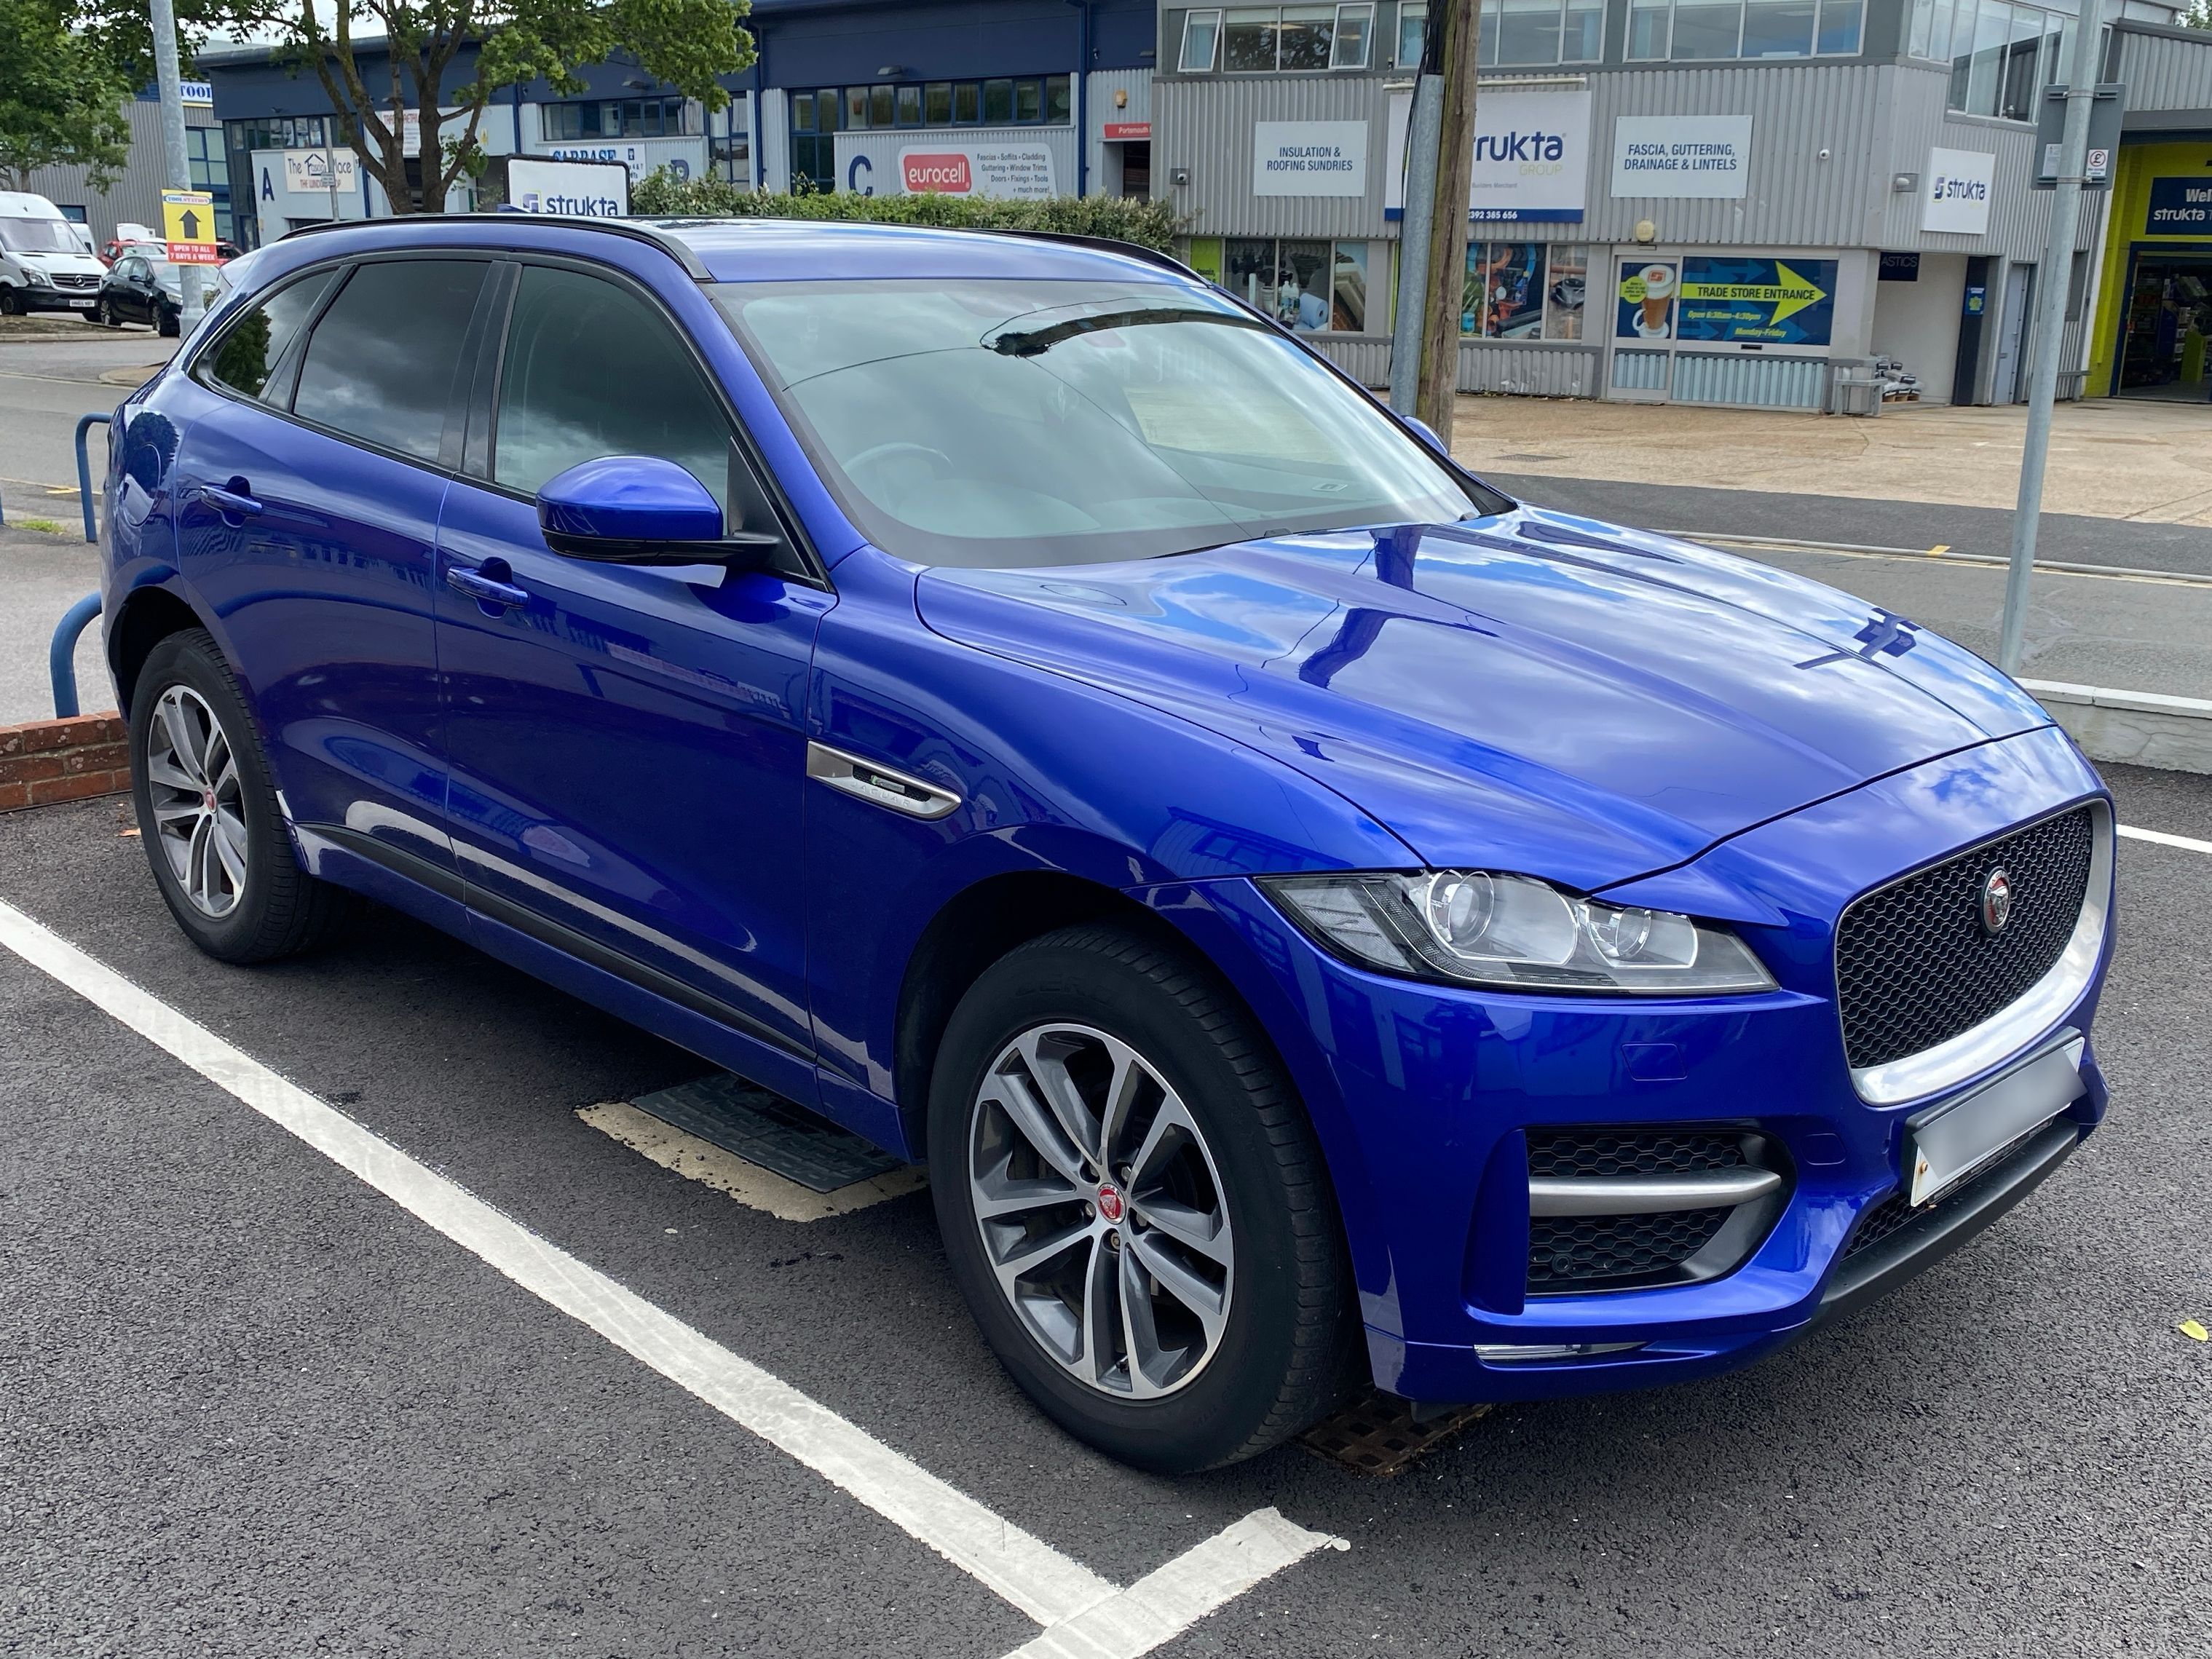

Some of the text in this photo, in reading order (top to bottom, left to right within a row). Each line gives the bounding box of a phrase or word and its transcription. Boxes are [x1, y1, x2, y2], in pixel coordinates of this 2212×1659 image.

[1279, 147, 1341, 157] INSULATION &
[1474, 131, 1563, 161] rukta
[1628, 144, 1735, 157] FASCIA, GUTTERING,
[1022, 153, 1046, 162] Cladding
[288, 158, 302, 174] The
[334, 157, 352, 174] lace
[981, 164, 1006, 173] Guttering
[1267, 160, 1353, 171] ROOFING SUNDRIES
[1520, 165, 1563, 175] GROUP
[1624, 159, 1737, 170] DRAINAGE & LINTELS
[848, 155, 873, 197] C
[909, 162, 965, 183] eurocell
[1011, 175, 1030, 183] Fixings
[262, 167, 275, 201] A
[1947, 178, 1986, 200] strukta
[2186, 189, 2212, 202] Wel
[546, 195, 618, 216] strukta
[1468, 210, 1517, 219] 392 385 656
[2153, 208, 2205, 221] strukta
[1697, 286, 1815, 301] TRADE STORE ENTRANCE
